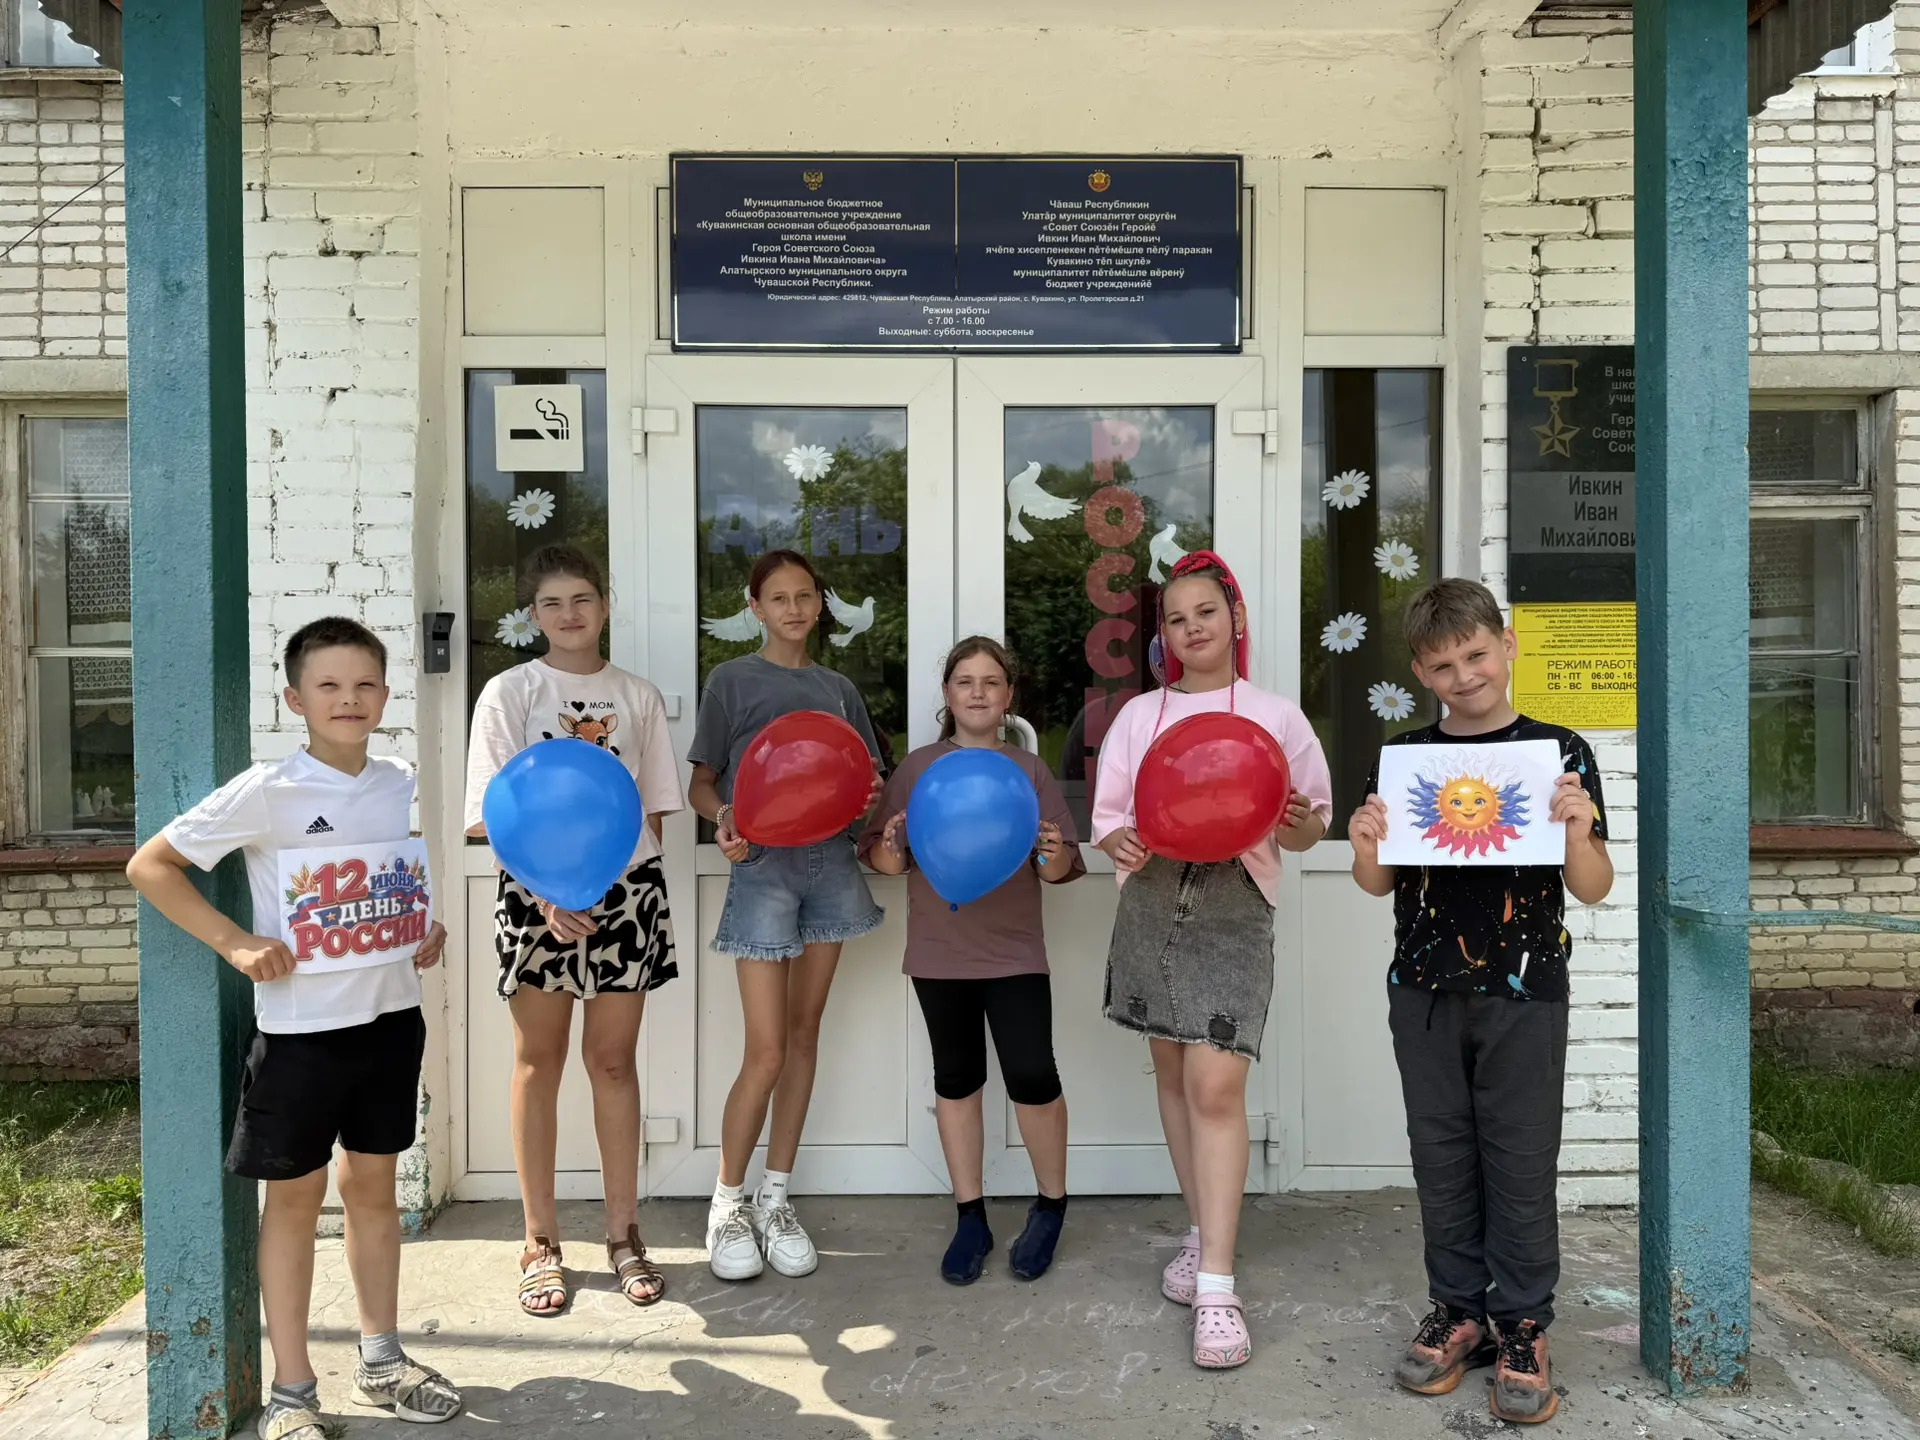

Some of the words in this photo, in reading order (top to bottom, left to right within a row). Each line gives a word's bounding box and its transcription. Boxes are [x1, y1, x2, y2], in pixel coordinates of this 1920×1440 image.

[744, 198, 824, 208] Муниципальное
[826, 198, 883, 208] бюджетное
[1084, 200, 1150, 210] Республикин
[725, 209, 839, 219] общеобразовательное
[842, 211, 902, 220] учреждение
[1059, 213, 1135, 221] муниципалитет
[696, 220, 764, 231] «Кувакинская
[767, 222, 814, 230] основная
[817, 221, 931, 232] общеобразовательная
[1043, 222, 1078, 231] «Совет
[1038, 234, 1068, 242] Ивкин
[1071, 234, 1096, 242] Иван
[1098, 234, 1160, 242] Михайлович
[752, 243, 780, 253] Героя
[784, 244, 840, 252] Советского
[843, 244, 875, 252] Союза
[1172, 247, 1212, 255] паракан
[741, 254, 777, 263] Ивкина
[780, 255, 810, 264] Ивана
[813, 255, 886, 264] Михайловича»
[1046, 257, 1094, 267] Кувакино
[720, 266, 786, 276] Алатырского
[788, 268, 872, 277] муниципального
[874, 268, 908, 278] округа
[1013, 270, 1090, 278] муниципалитет
[754, 278, 810, 288] Чувашской
[812, 278, 874, 288] Республики.
[1046, 280, 1084, 289] бюджет
[922, 306, 952, 314] Режим
[956, 307, 990, 316] работы
[879, 327, 931, 336] Выходные:
[934, 327, 974, 337] суббота,
[976, 329, 1034, 337] воскресенье
[1604, 366, 1614, 377] В
[1611, 413, 1635, 428] Гер
[1568, 474, 1622, 496] Ивкин
[1574, 501, 1618, 522] Иван
[1548, 660, 1592, 670] РЕЖИМ
[1548, 672, 1560, 680] ПН
[1569, 672, 1581, 680] ПТ
[1624, 672, 1637, 680] 16:
[1548, 682, 1560, 690] СБ
[1570, 682, 1582, 690] ВС
[306, 826, 334, 835] adidas
[312, 858, 370, 907] 12
[370, 871, 415, 892] ИЮНЯ
[338, 897, 402, 923] ДЕНЬ
[293, 909, 427, 961] РОССИИ
